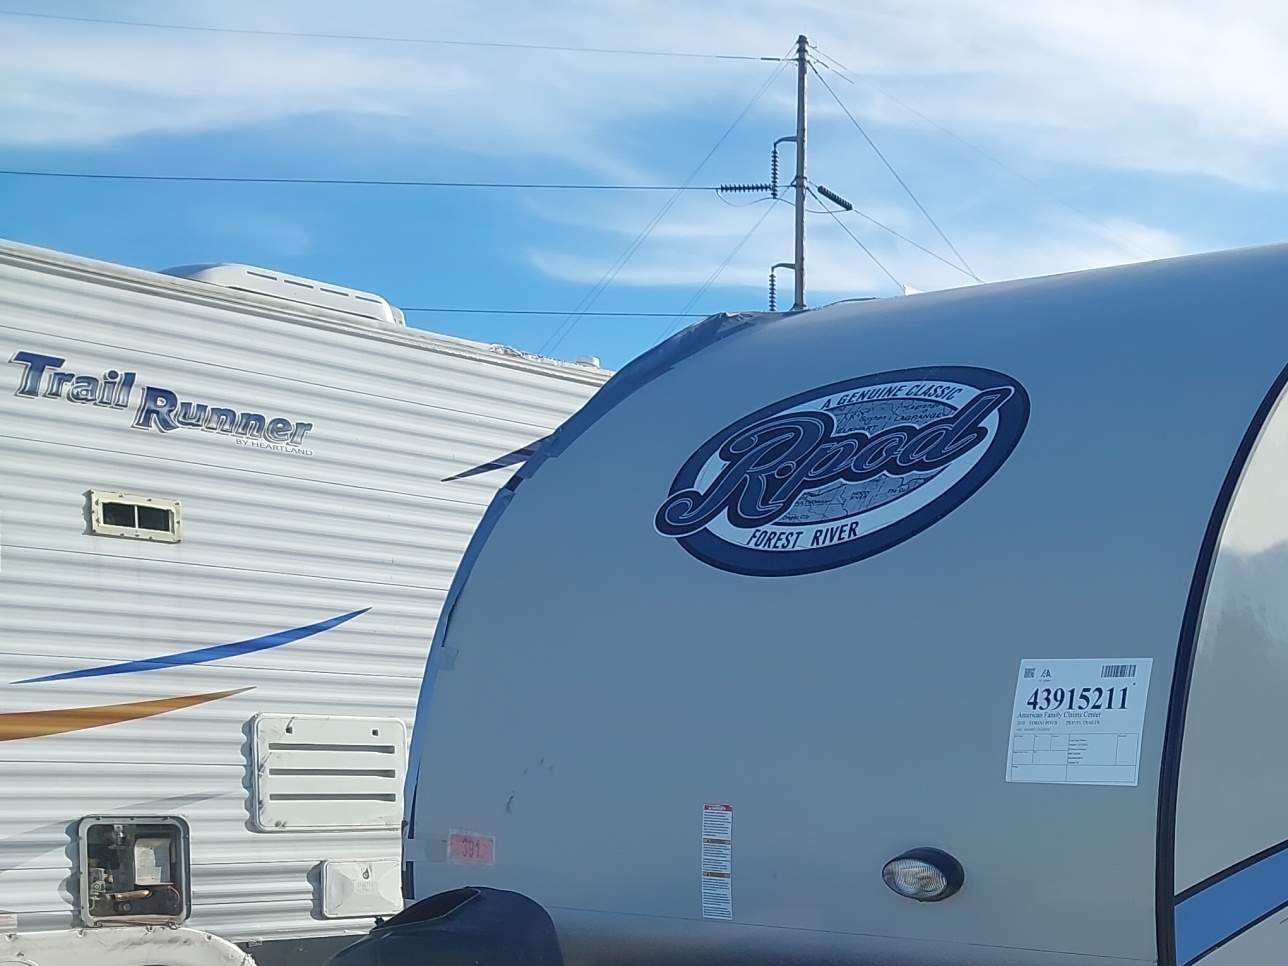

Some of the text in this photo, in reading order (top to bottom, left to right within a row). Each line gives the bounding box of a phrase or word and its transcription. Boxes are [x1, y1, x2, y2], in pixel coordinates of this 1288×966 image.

[9, 350, 313, 446] Trail Runner
[821, 384, 963, 410] A GENUINE CLASSIC
[235, 438, 313, 456] BY HEARTLAND
[747, 521, 859, 549] FOREST RIVER
[1027, 687, 1128, 710] 43915211
